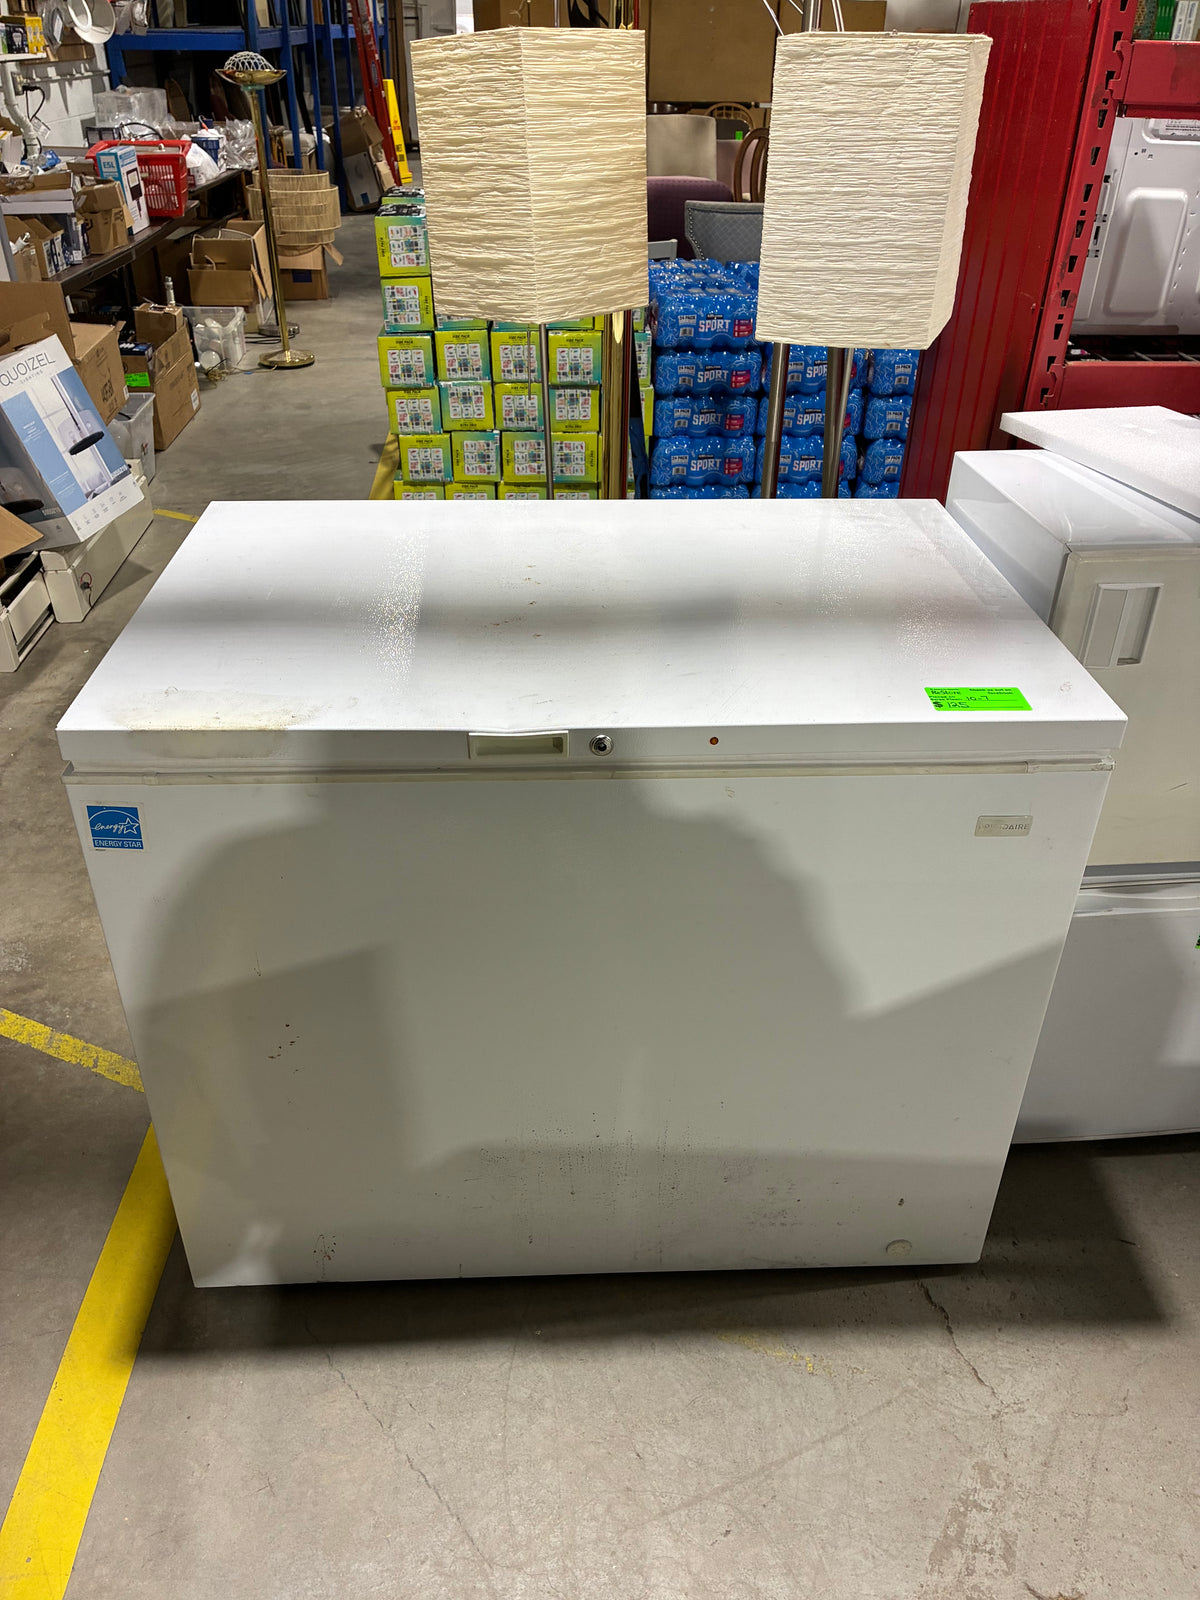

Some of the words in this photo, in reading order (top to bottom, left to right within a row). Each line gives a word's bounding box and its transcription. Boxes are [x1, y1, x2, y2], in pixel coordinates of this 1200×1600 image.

[698, 319, 731, 333] SPORT
[0, 352, 56, 387] QUOIZEL
[697, 370, 729, 383] SPORT
[692, 413, 723, 426] SPORT
[690, 459, 721, 471] SPORT
[792, 460, 824, 471] SPORT
[123, 840, 142, 848] STAR
